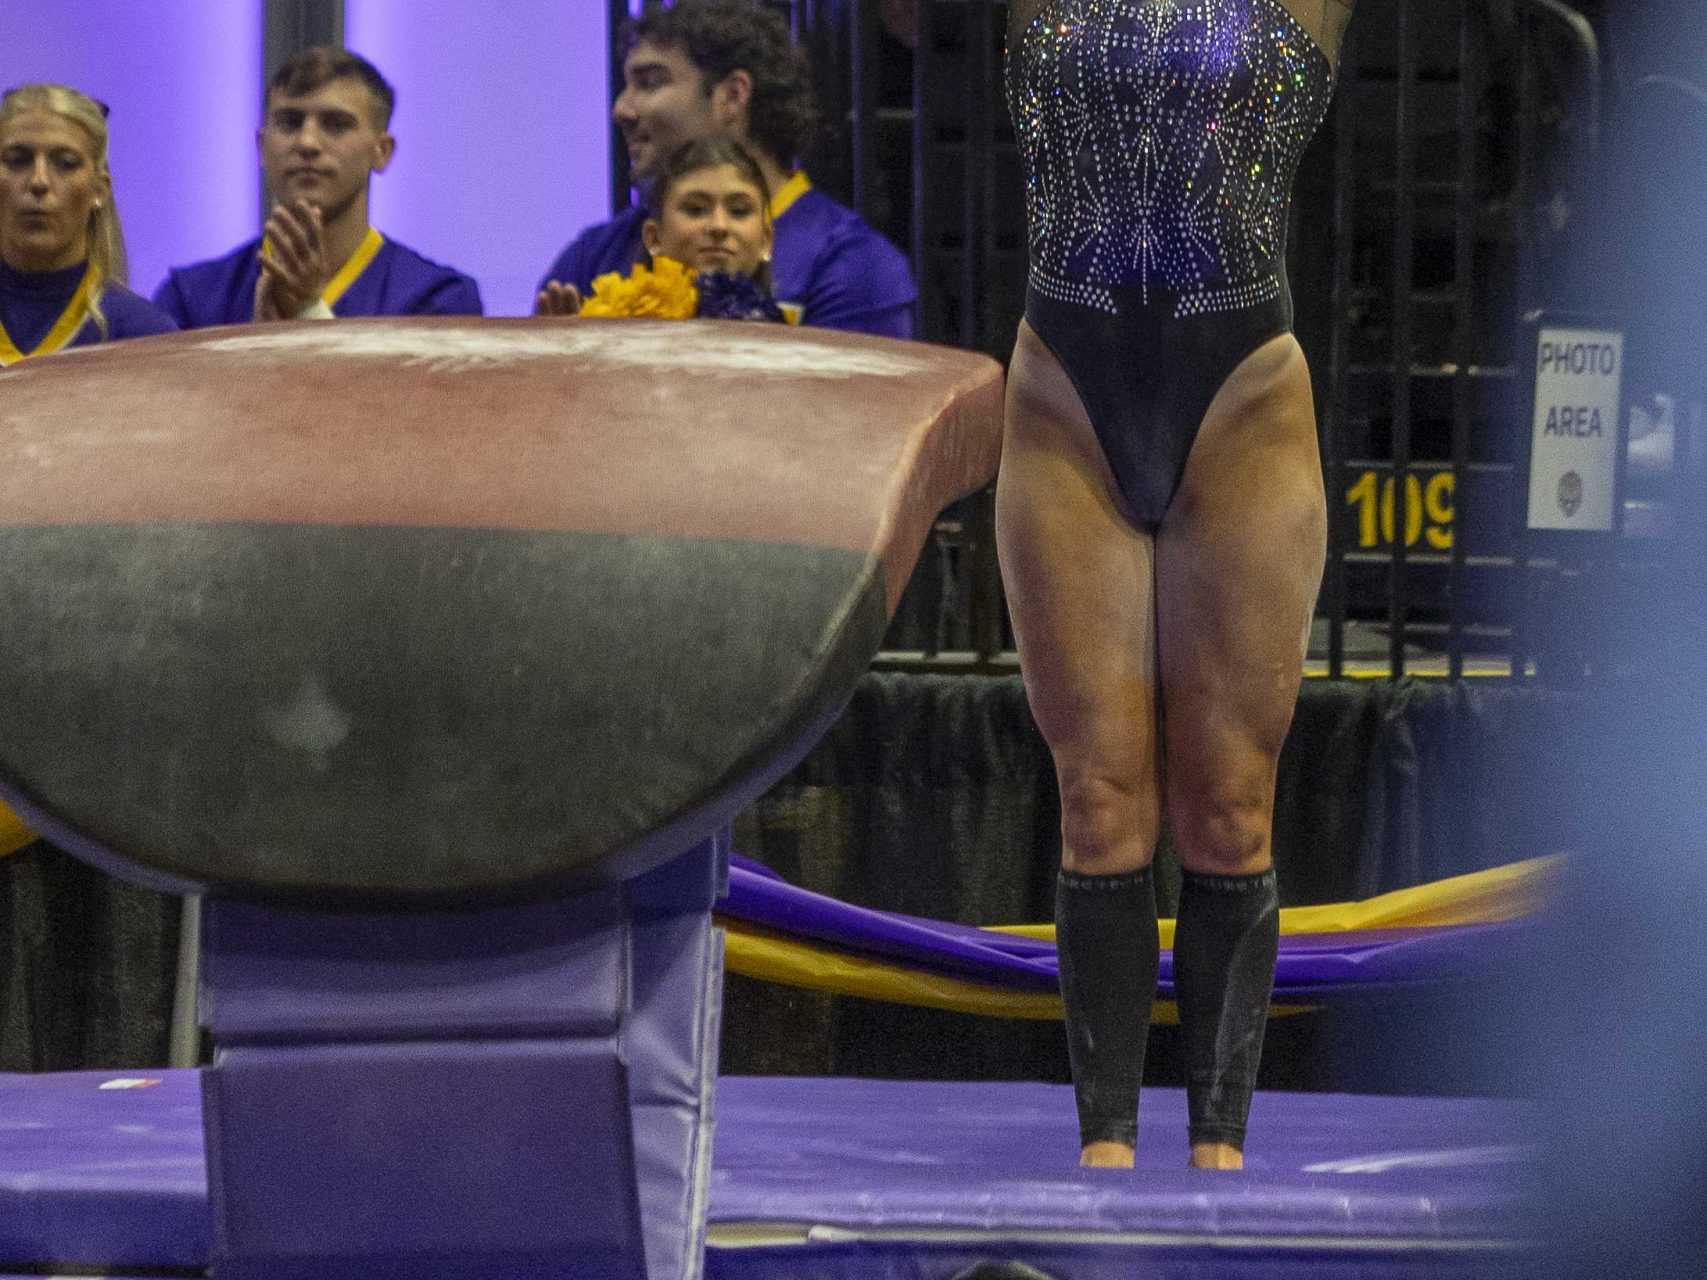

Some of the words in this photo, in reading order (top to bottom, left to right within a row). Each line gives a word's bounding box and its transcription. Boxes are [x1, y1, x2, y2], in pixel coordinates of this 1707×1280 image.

[1539, 343, 1615, 375] PHOTO
[1544, 406, 1603, 438] AREA
[1345, 469, 1455, 550] 109
